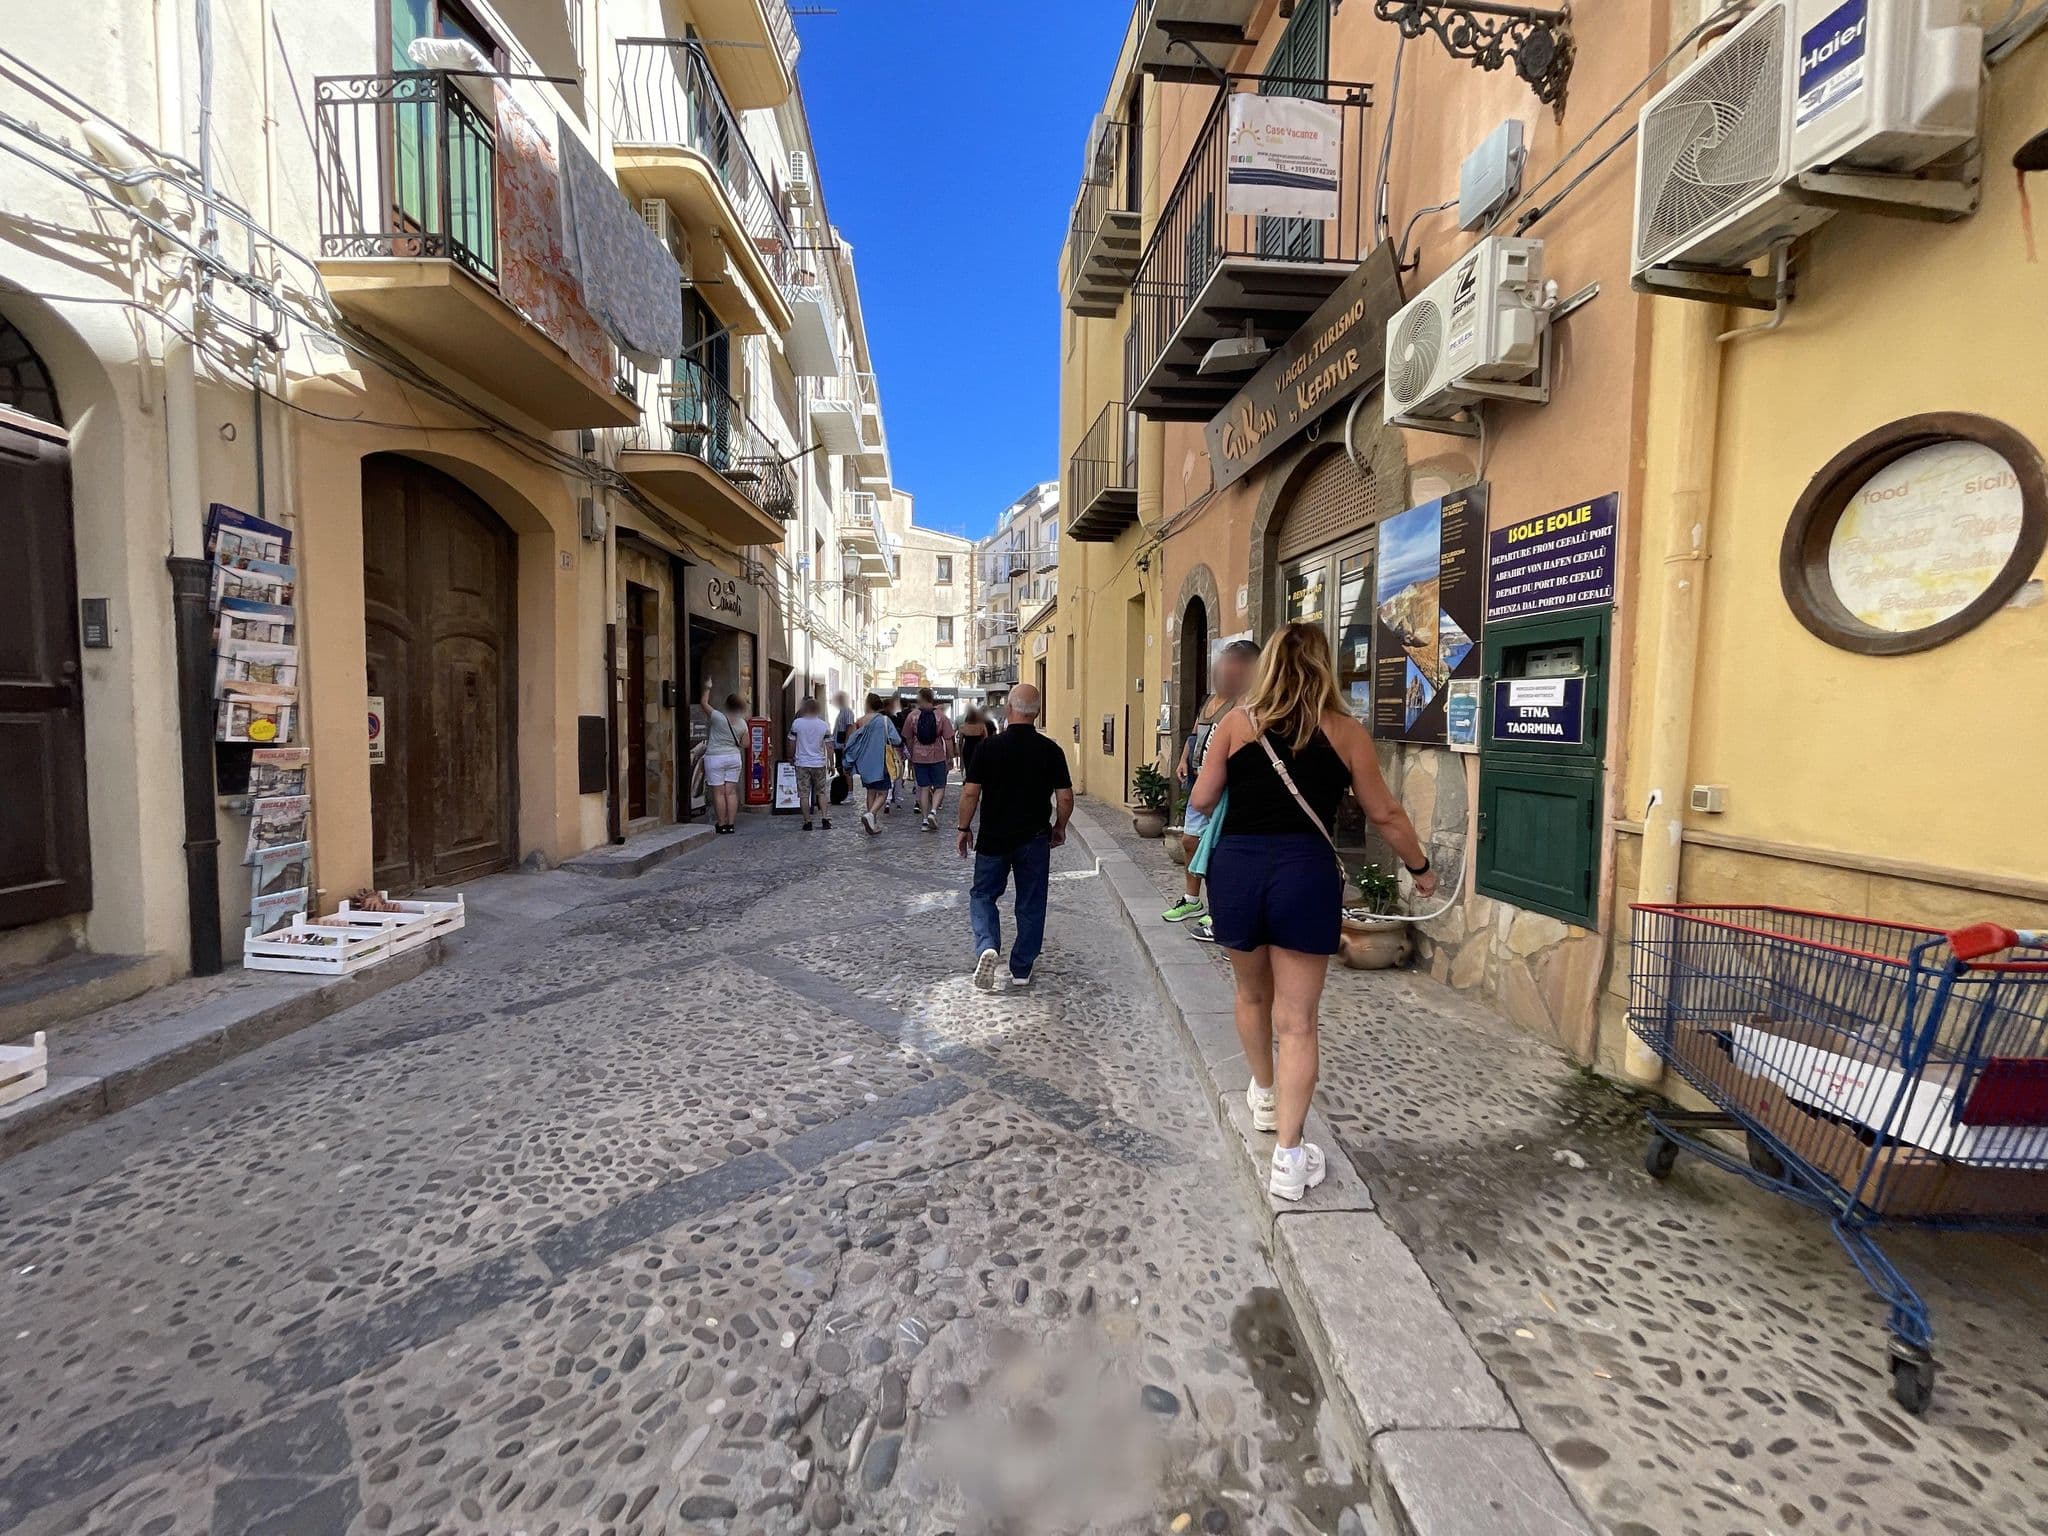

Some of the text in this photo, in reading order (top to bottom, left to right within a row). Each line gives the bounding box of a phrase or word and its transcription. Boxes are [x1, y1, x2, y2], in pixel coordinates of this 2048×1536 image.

[1800, 16, 1865, 77] Haier
[1265, 124, 1286, 136] Case
[1286, 128, 1319, 140] Vacanze
[1275, 352, 1307, 394] VIAGGI
[1312, 298, 1365, 360] TURISMO
[1297, 348, 1360, 411] KEFATUR
[1864, 471, 2019, 504] food sicily
[1508, 505, 1592, 543] ISOLE EOLIE
[1491, 547, 1532, 565] DEPARTURE
[1533, 541, 1555, 555] FROM
[1590, 525, 1613, 540] PORT
[1495, 567, 1527, 582] ABFAHRT
[1527, 563, 1543, 574] VON
[1543, 555, 1573, 570] HAFEN
[1496, 585, 1522, 599] DEPART
[1522, 582, 1533, 592] DU
[1534, 578, 1556, 591] PORT
[1556, 576, 1569, 585] DE
[1489, 605, 1522, 617] PARTENZA
[1522, 600, 1538, 611] DAL
[1538, 595, 1565, 607] PORTO
[1566, 593, 1577, 603] DI
[1520, 706, 1550, 719] ETNA
[1507, 722, 1564, 735] TAORMINA
